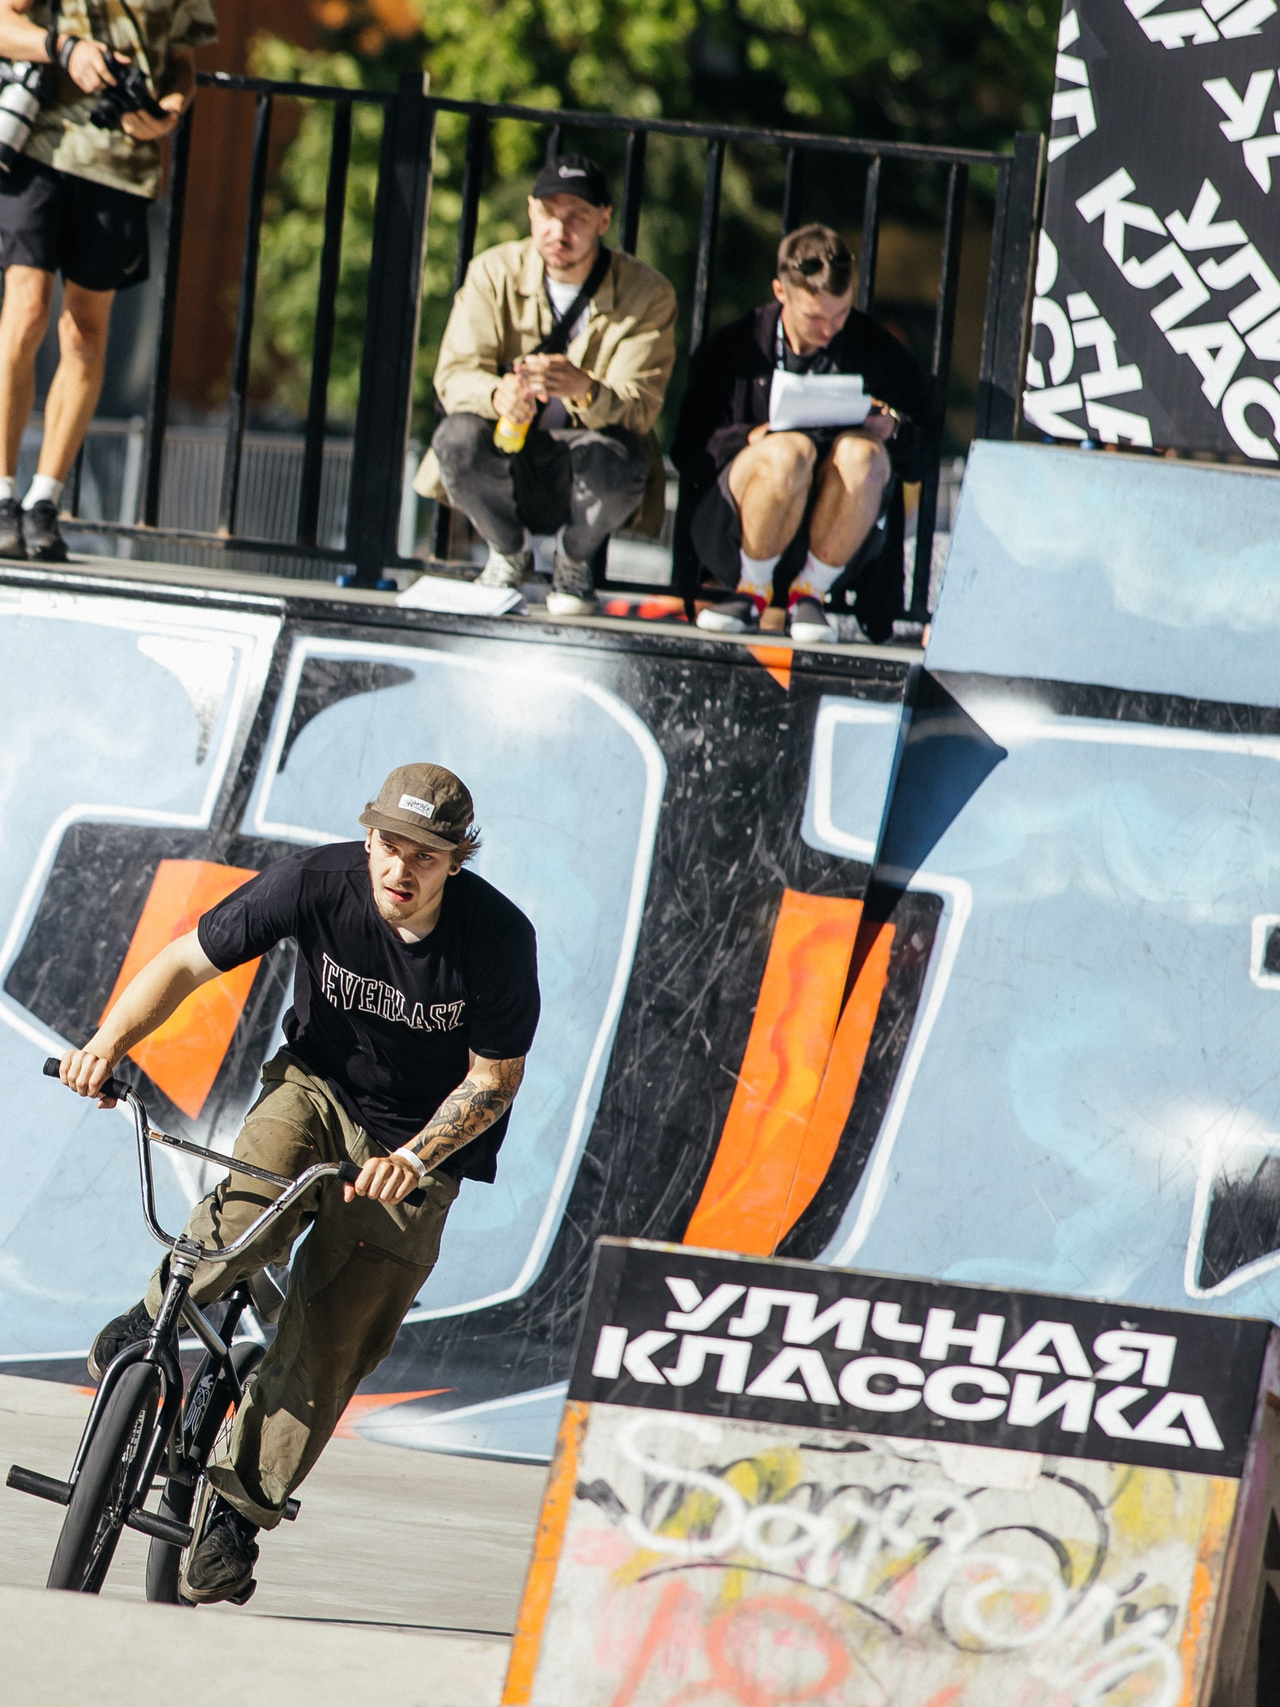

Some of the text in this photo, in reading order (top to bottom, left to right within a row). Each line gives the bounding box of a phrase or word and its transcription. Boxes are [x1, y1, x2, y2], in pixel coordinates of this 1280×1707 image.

[322, 952, 465, 1032] EVERLAST
[591, 1325, 1225, 1451] КЛАССИКА
[665, 1276, 1178, 1388] УЛИЧНАЯ
